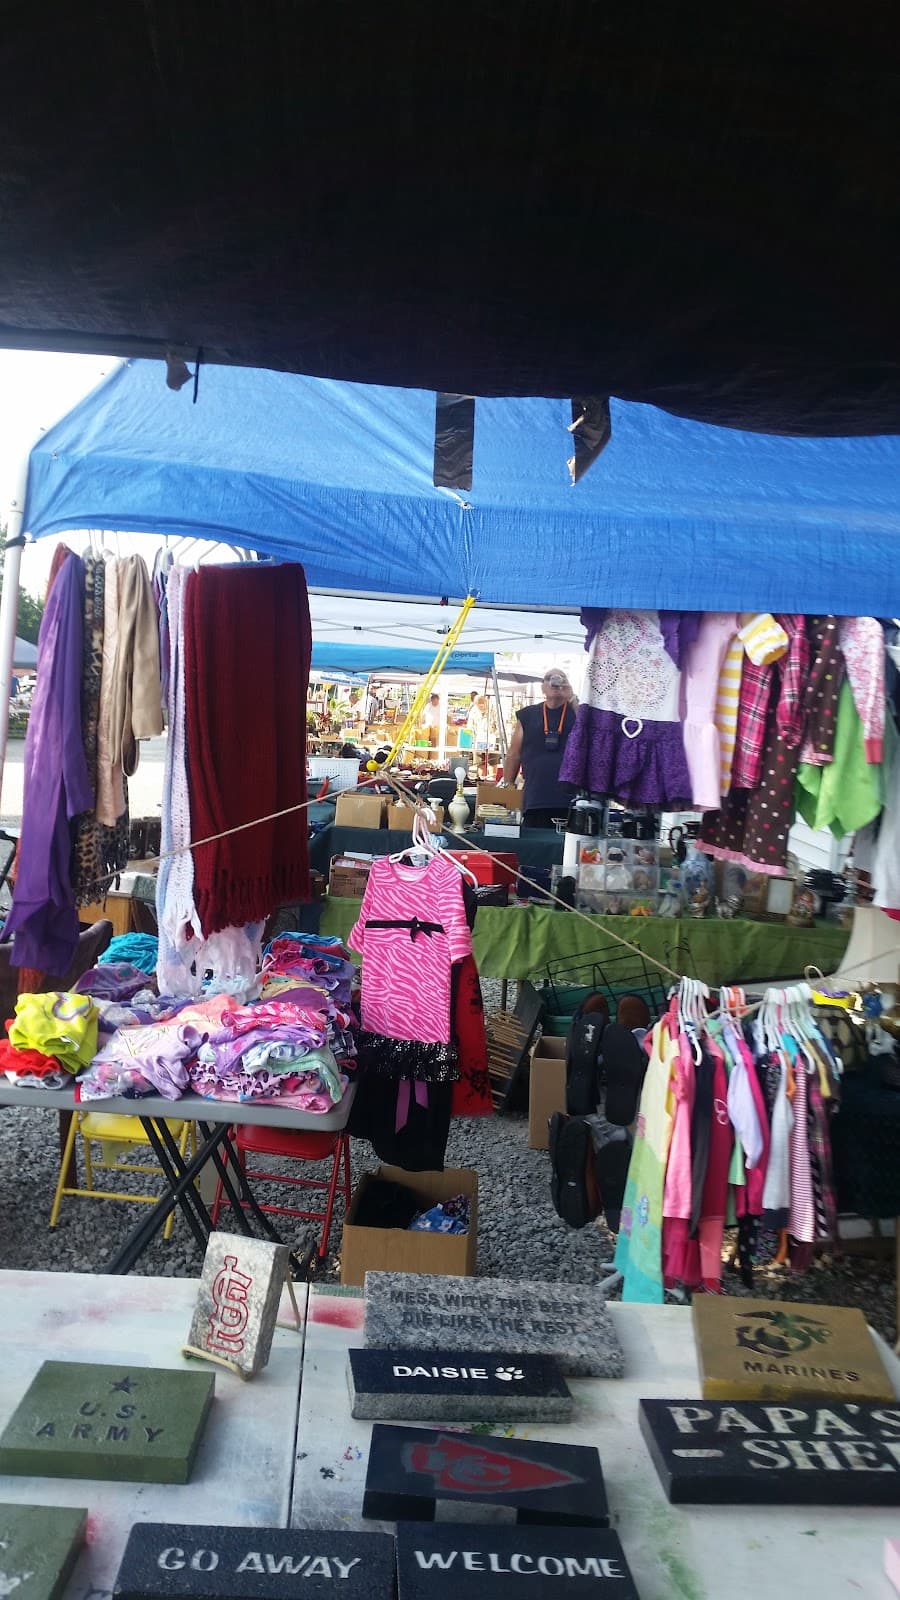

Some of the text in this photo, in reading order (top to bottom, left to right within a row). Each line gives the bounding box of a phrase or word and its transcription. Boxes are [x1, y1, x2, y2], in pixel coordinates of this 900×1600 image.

[390, 1290, 586, 1315] MESS WITH THE BEST
[402, 1310, 580, 1336] DIE LIKE THE REST
[392, 1365, 489, 1380] DAISIE
[743, 1361, 861, 1383] MARINES
[36, 1422, 164, 1443] ARMY
[666, 1403, 900, 1439] PAPA'S
[157, 1547, 362, 1579] GO AWAY
[413, 1550, 627, 1579] WELCOME
